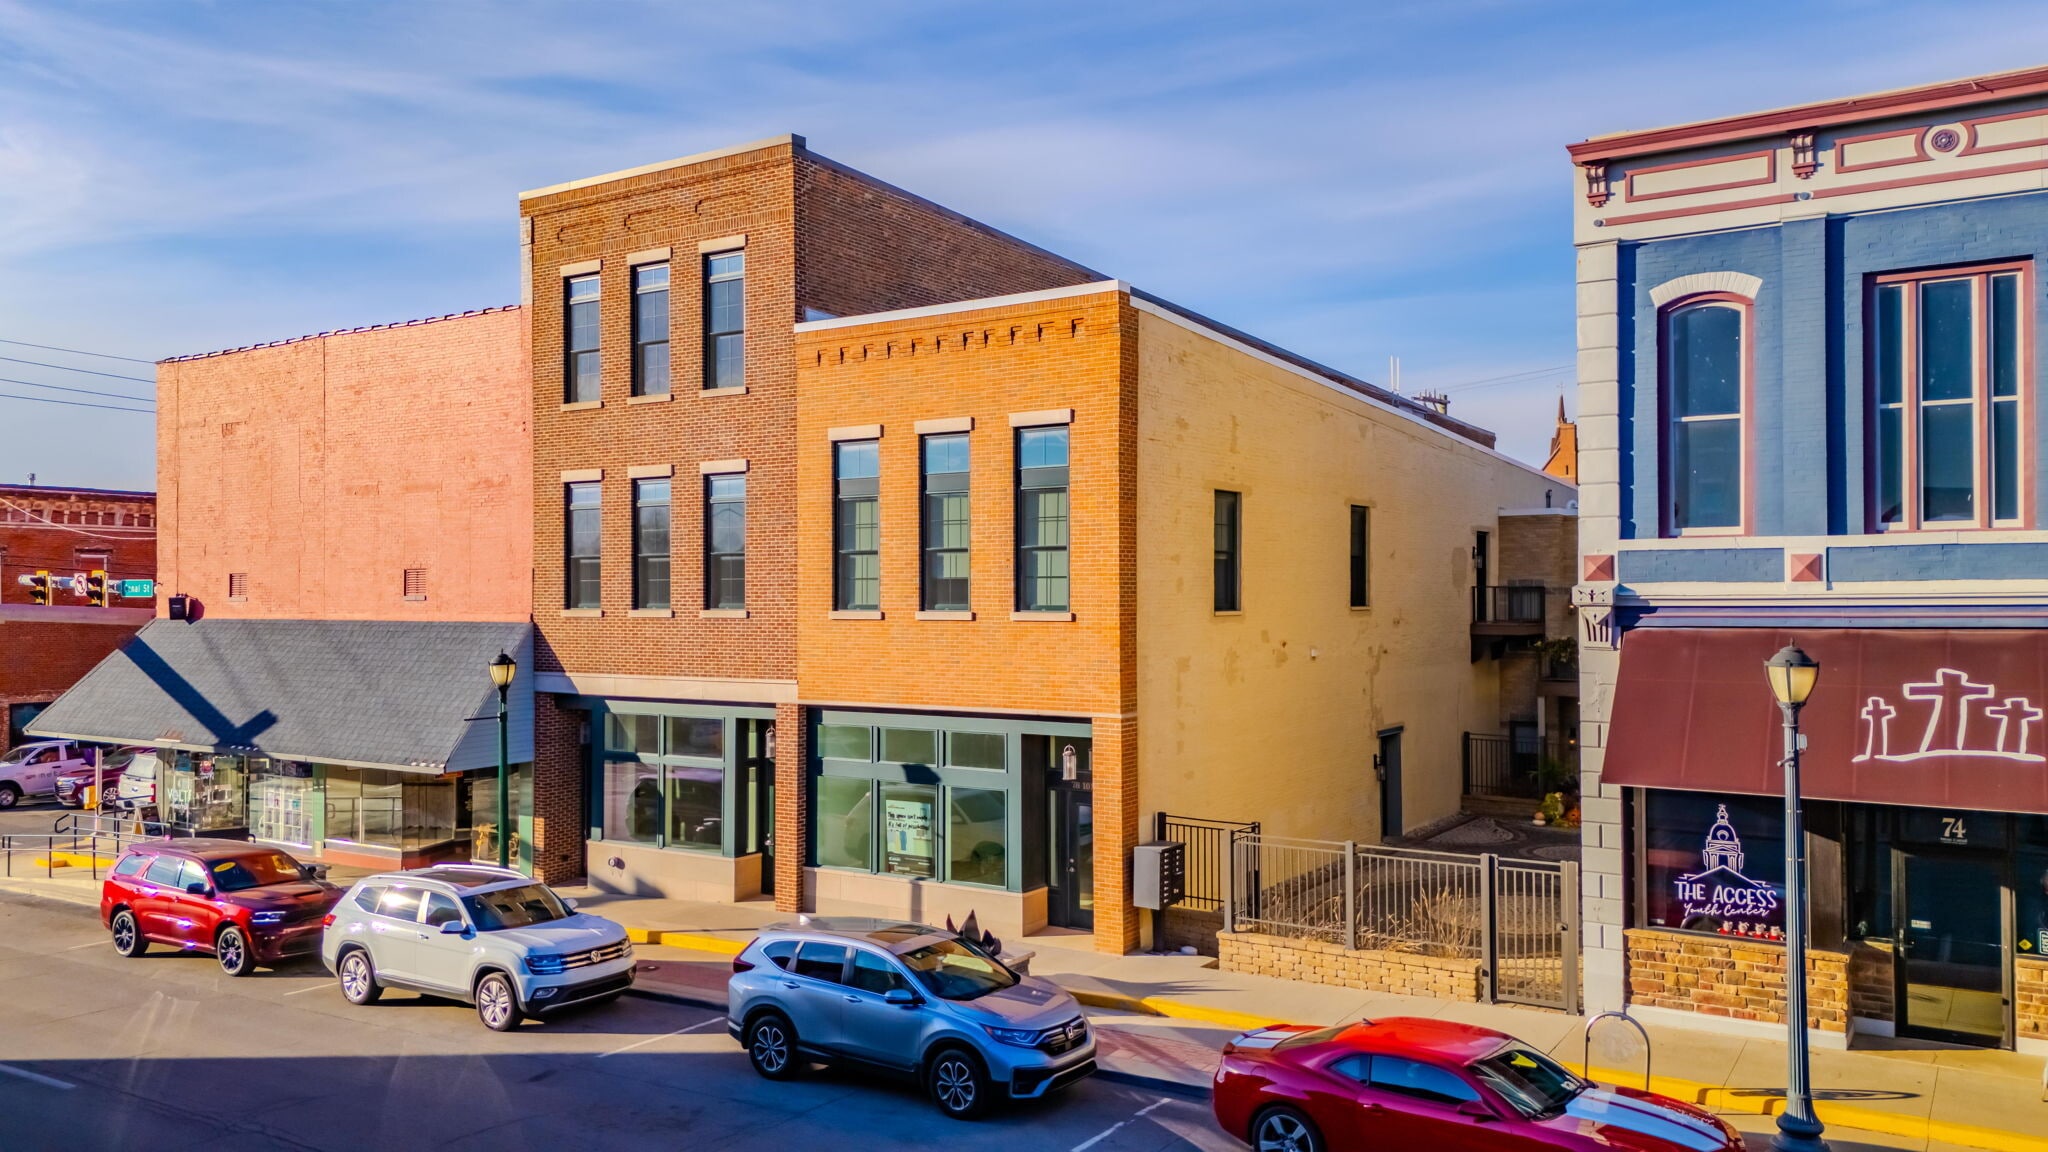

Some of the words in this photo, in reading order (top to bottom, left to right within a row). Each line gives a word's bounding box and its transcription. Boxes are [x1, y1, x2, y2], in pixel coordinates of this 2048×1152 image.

[143, 584, 150, 593] St
[1942, 818, 1966, 838] 74
[1674, 881, 1706, 900] THE
[1713, 885, 1777, 908] ACCESS
[1683, 902, 1721, 916] Youth
[1723, 904, 1770, 916] Center
